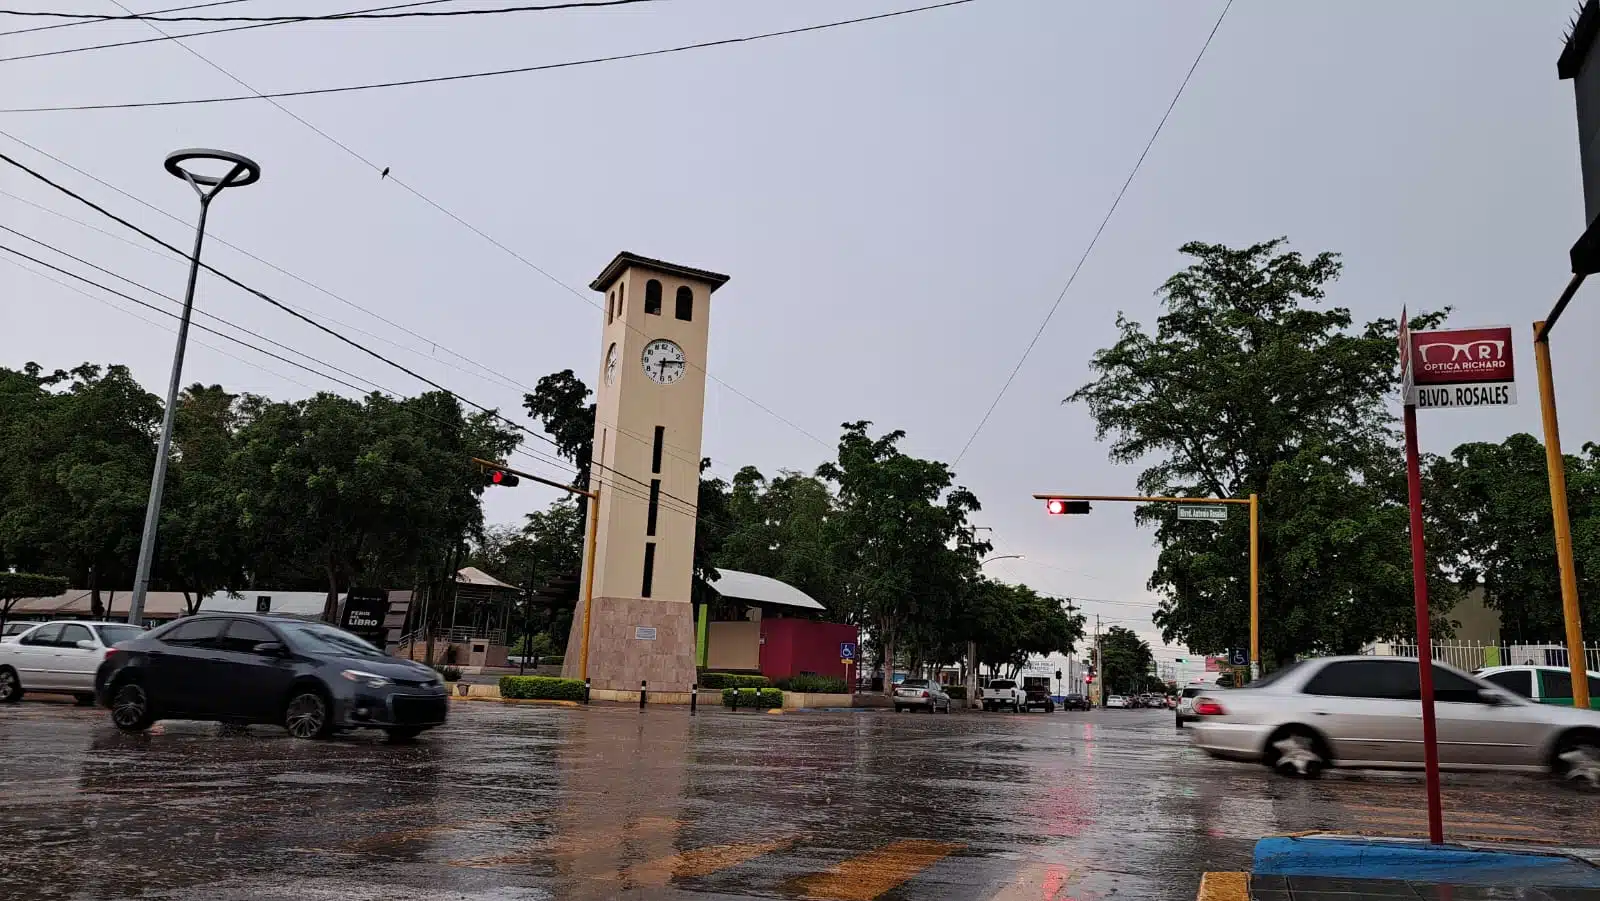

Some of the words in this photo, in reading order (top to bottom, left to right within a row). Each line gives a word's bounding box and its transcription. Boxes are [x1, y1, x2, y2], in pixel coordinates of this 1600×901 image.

[1462, 360, 1506, 369] RICHARD
[1419, 388, 1453, 407] BLVD.
[1456, 385, 1509, 406] ROSALES
